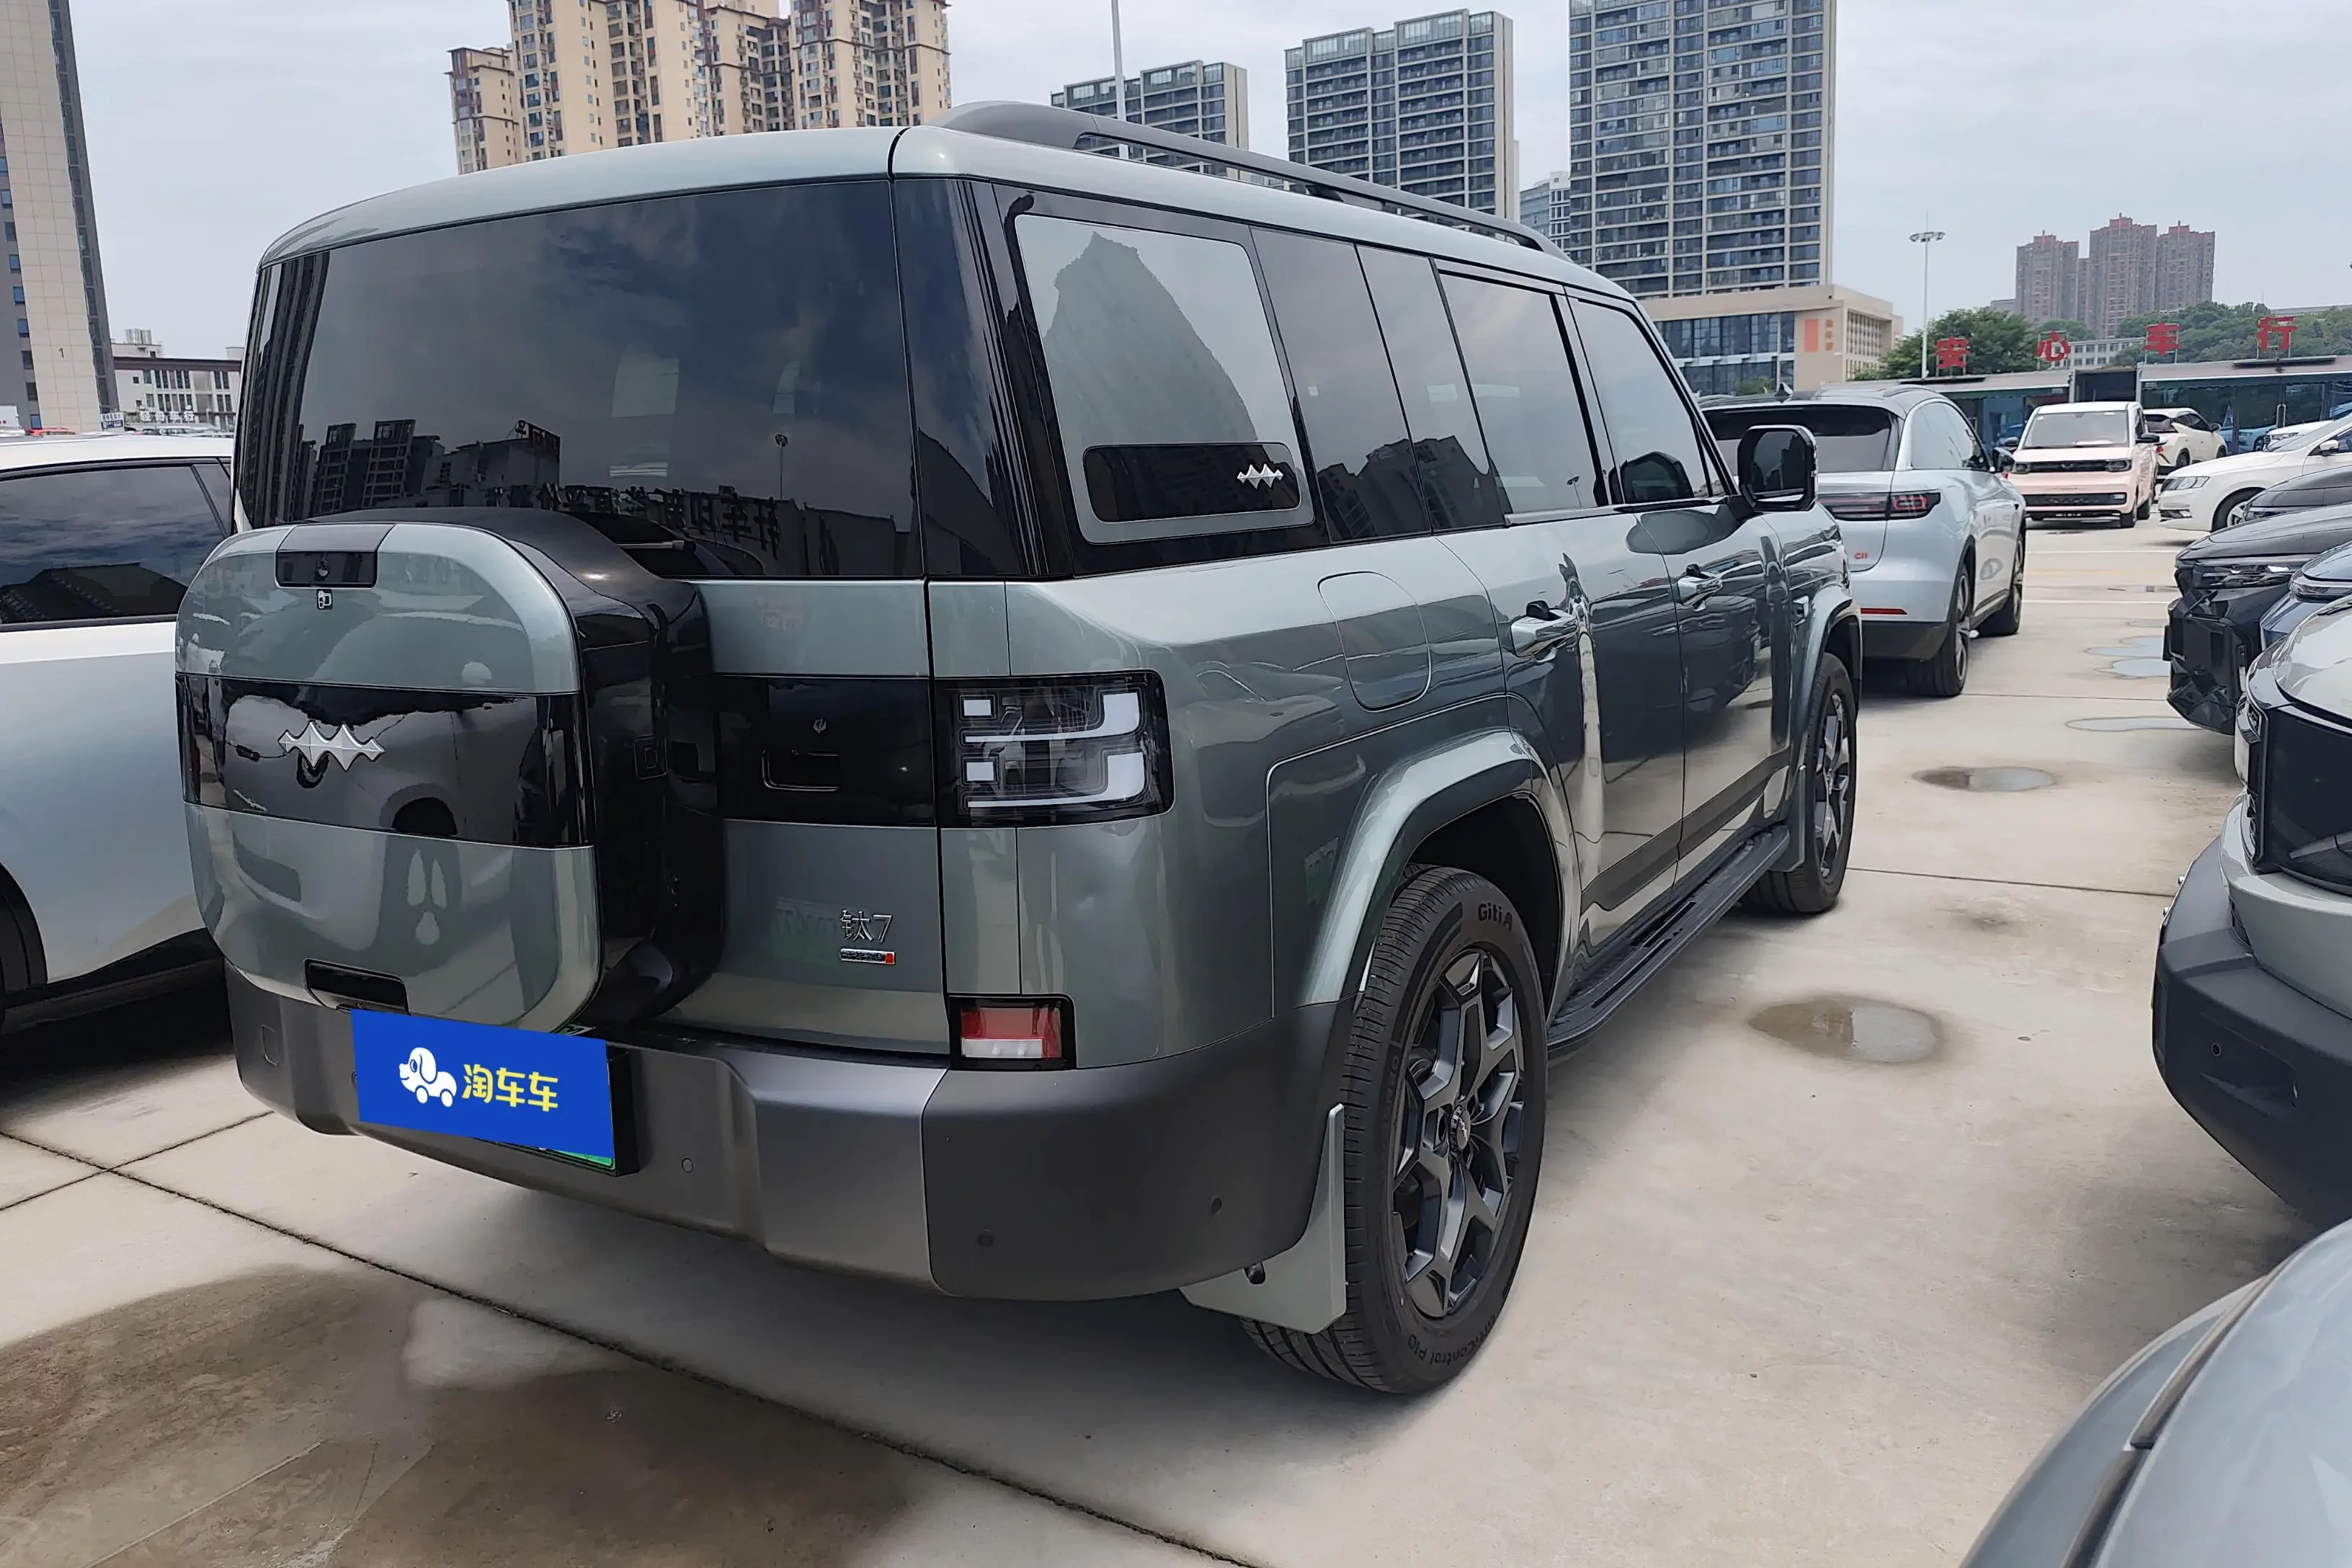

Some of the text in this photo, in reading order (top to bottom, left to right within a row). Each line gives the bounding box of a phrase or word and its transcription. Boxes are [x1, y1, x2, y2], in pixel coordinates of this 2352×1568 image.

[1935, 316, 2297, 369] 安心车行
[839, 909, 893, 943] 钛7
